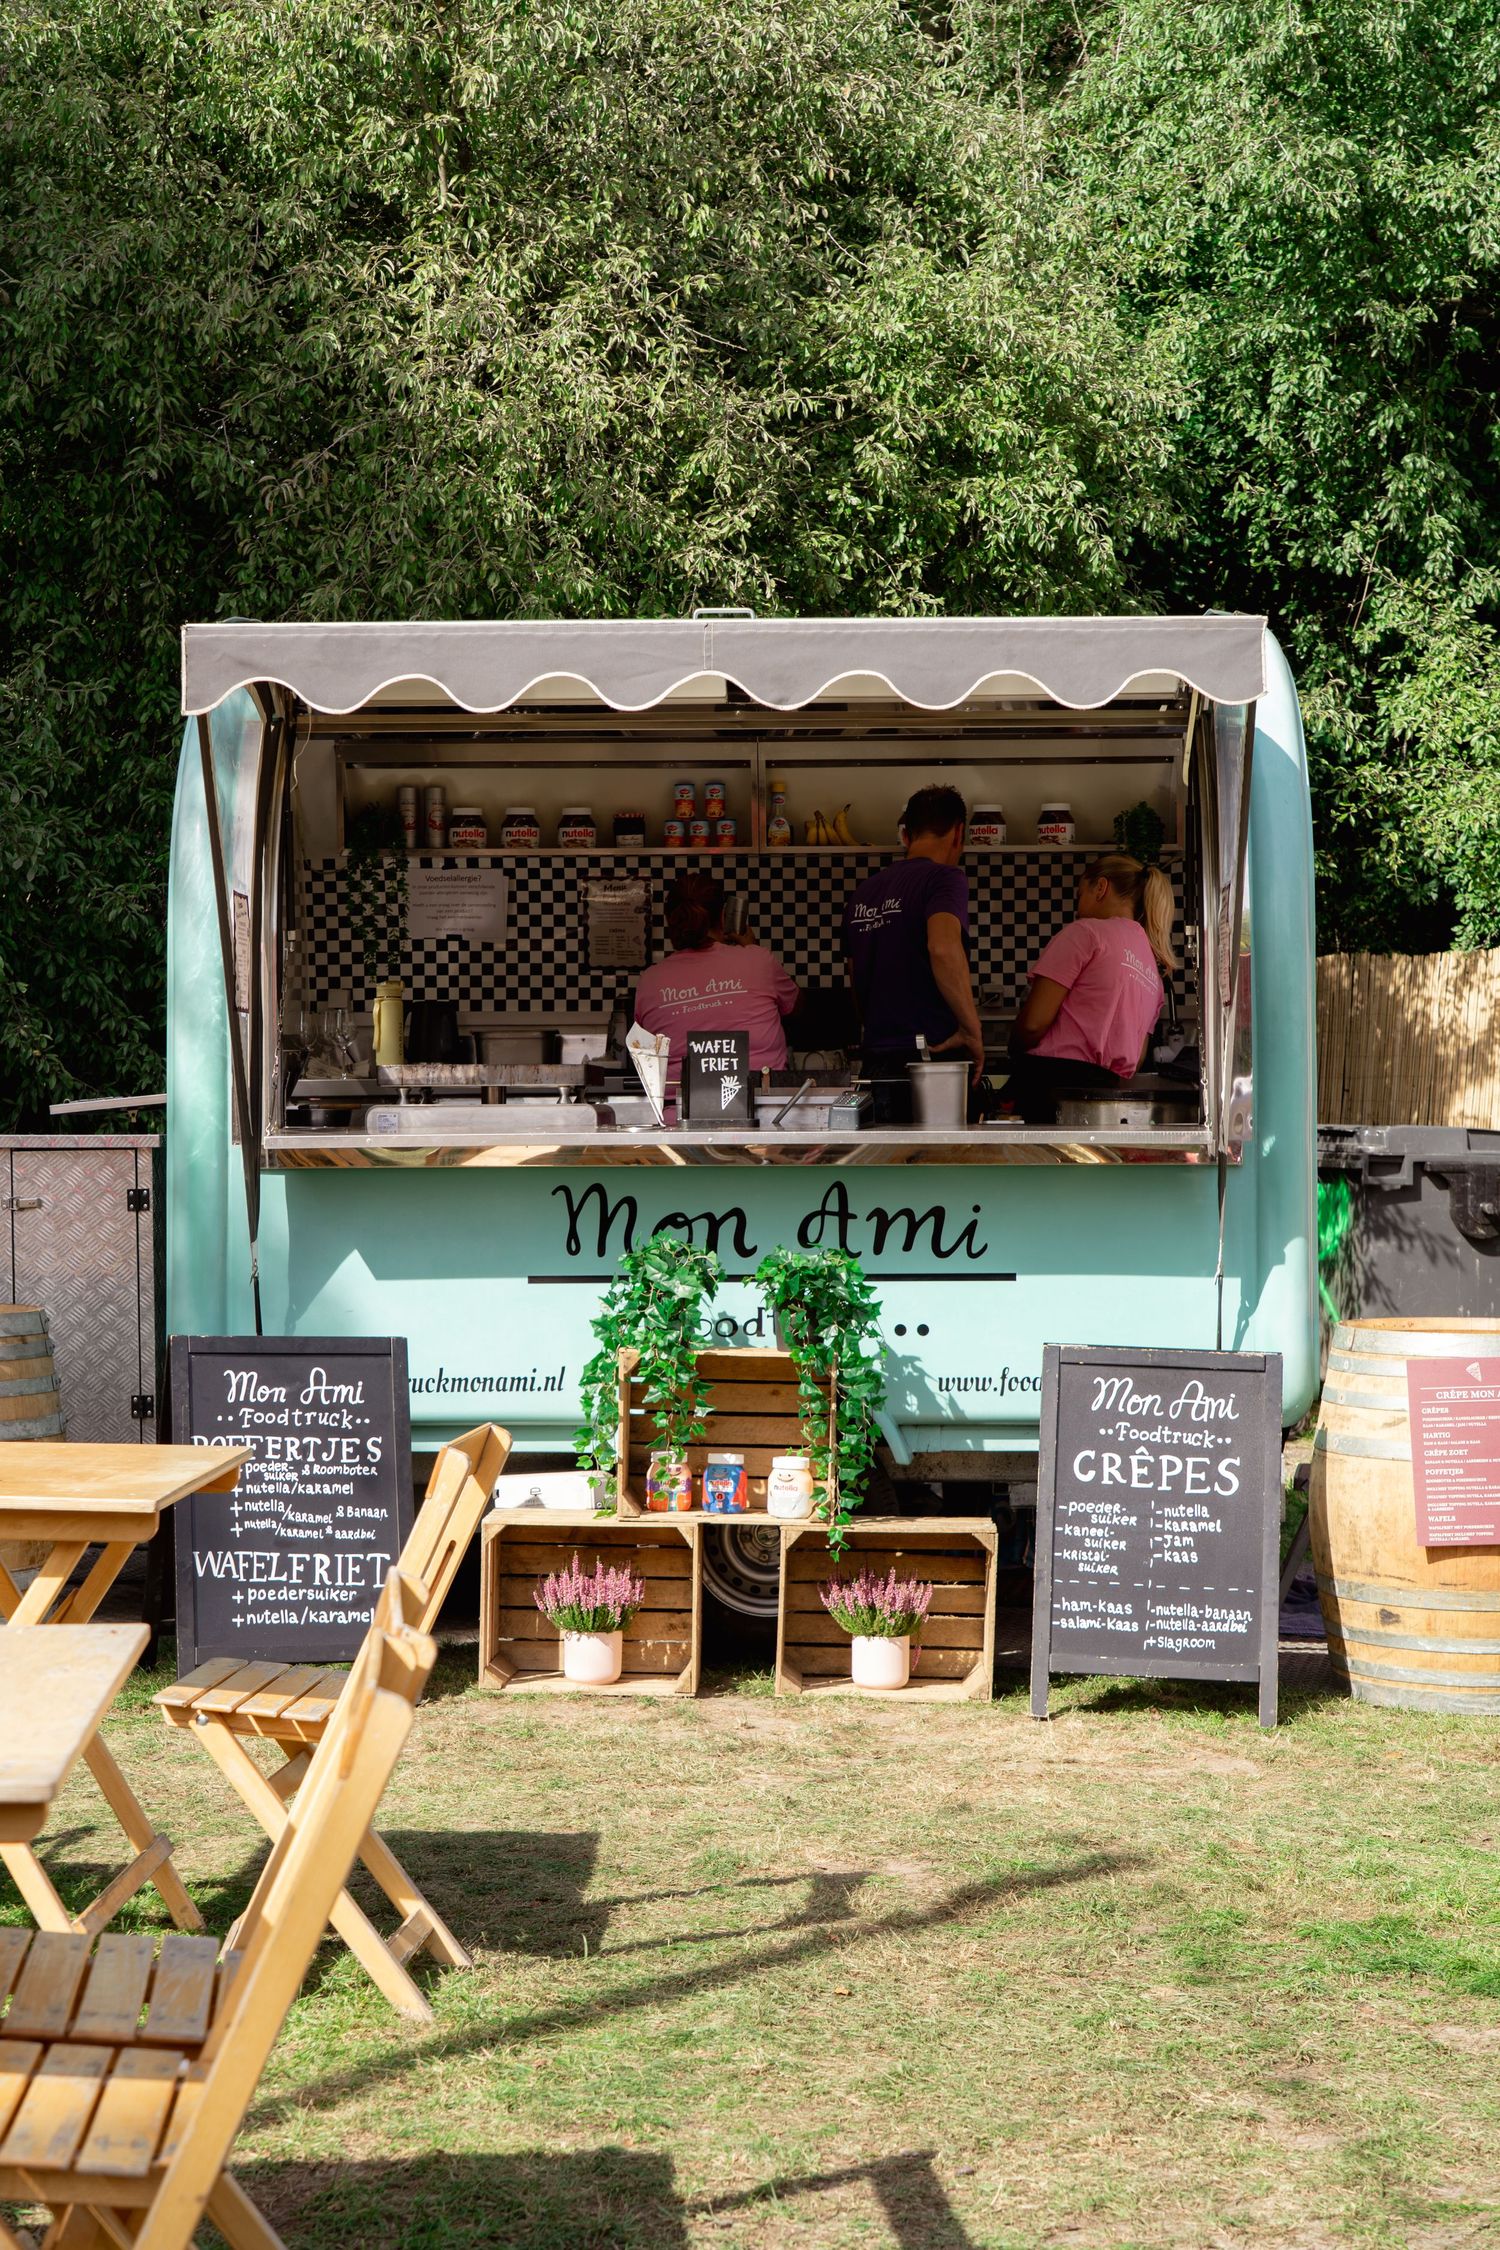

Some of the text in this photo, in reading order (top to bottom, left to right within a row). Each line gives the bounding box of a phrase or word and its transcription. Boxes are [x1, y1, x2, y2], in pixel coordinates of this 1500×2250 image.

[452, 829, 485, 838] nutella
[505, 829, 538, 838] nutella
[562, 829, 594, 838] nutella
[425, 873, 482, 882] Voedselallergie?
[660, 978, 743, 1002] Mon Ami
[689, 1039, 736, 1054] WAFEL
[700, 1057, 739, 1073] FRIET
[551, 1180, 989, 1259] Mon Ami
[223, 1367, 364, 1405] Mon Ami
[409, 1366, 566, 1393] uckmonami.nl
[1091, 1376, 1240, 1422] Mon Ami
[1436, 1389, 1468, 1400] CRÊPE
[1471, 1390, 1494, 1398] MON
[1074, 1446, 1241, 1496] CRÊPES
[192, 1550, 391, 1588] WAFELFRIET
